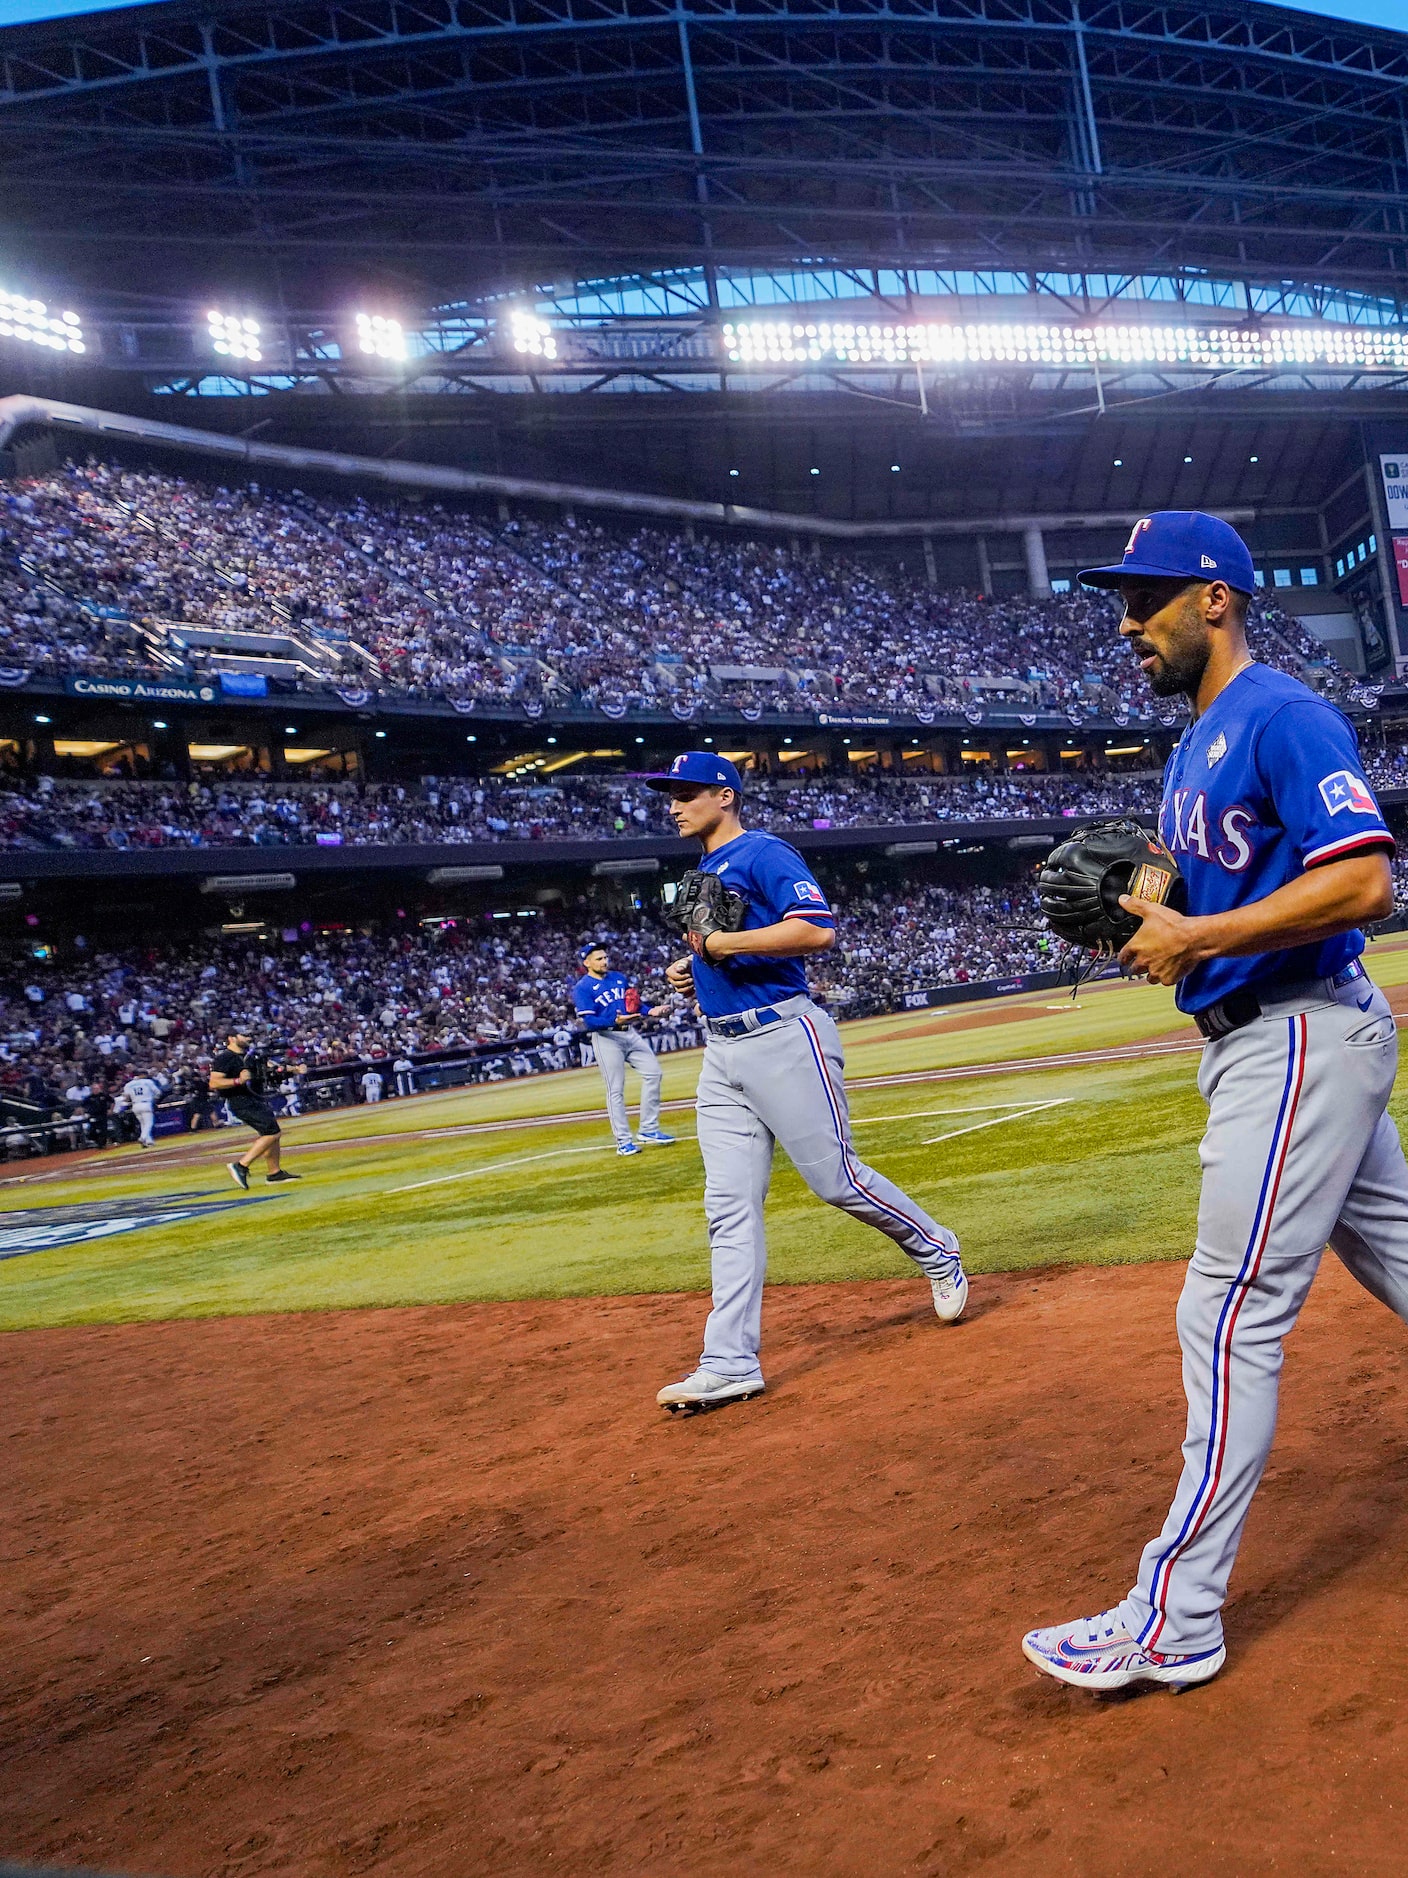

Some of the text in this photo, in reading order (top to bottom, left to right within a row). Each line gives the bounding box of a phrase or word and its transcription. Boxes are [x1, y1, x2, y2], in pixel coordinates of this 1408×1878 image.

[1125, 518, 1152, 554] T
[74, 679, 198, 700] CASINO ARIZONA
[672, 754, 689, 774] T
[905, 992, 928, 1008] FOX
